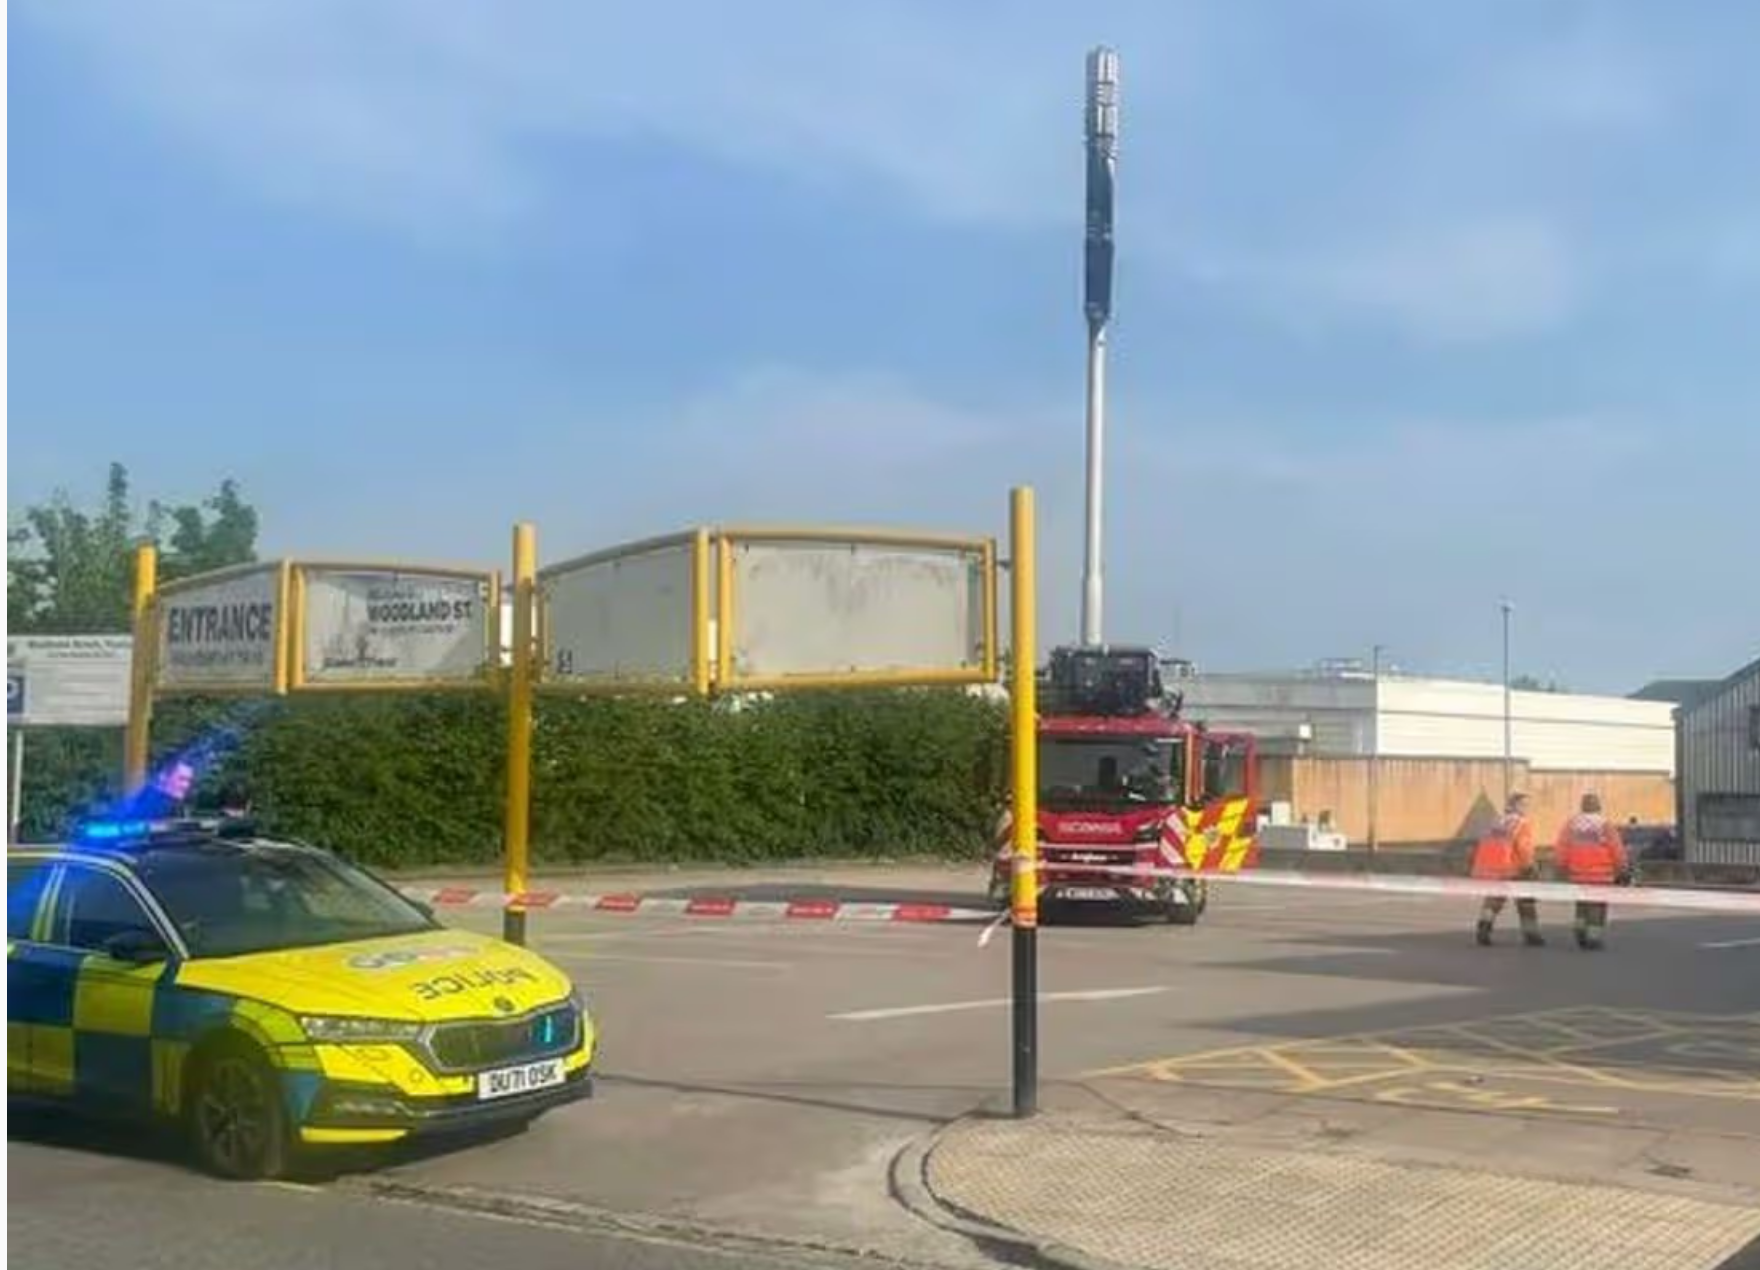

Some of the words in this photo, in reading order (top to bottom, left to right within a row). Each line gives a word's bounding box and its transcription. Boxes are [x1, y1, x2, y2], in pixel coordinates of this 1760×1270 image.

[168, 603, 272, 642] ENTRANCE
[366, 602, 451, 622] WOODLAND
[453, 600, 473, 620] ST
